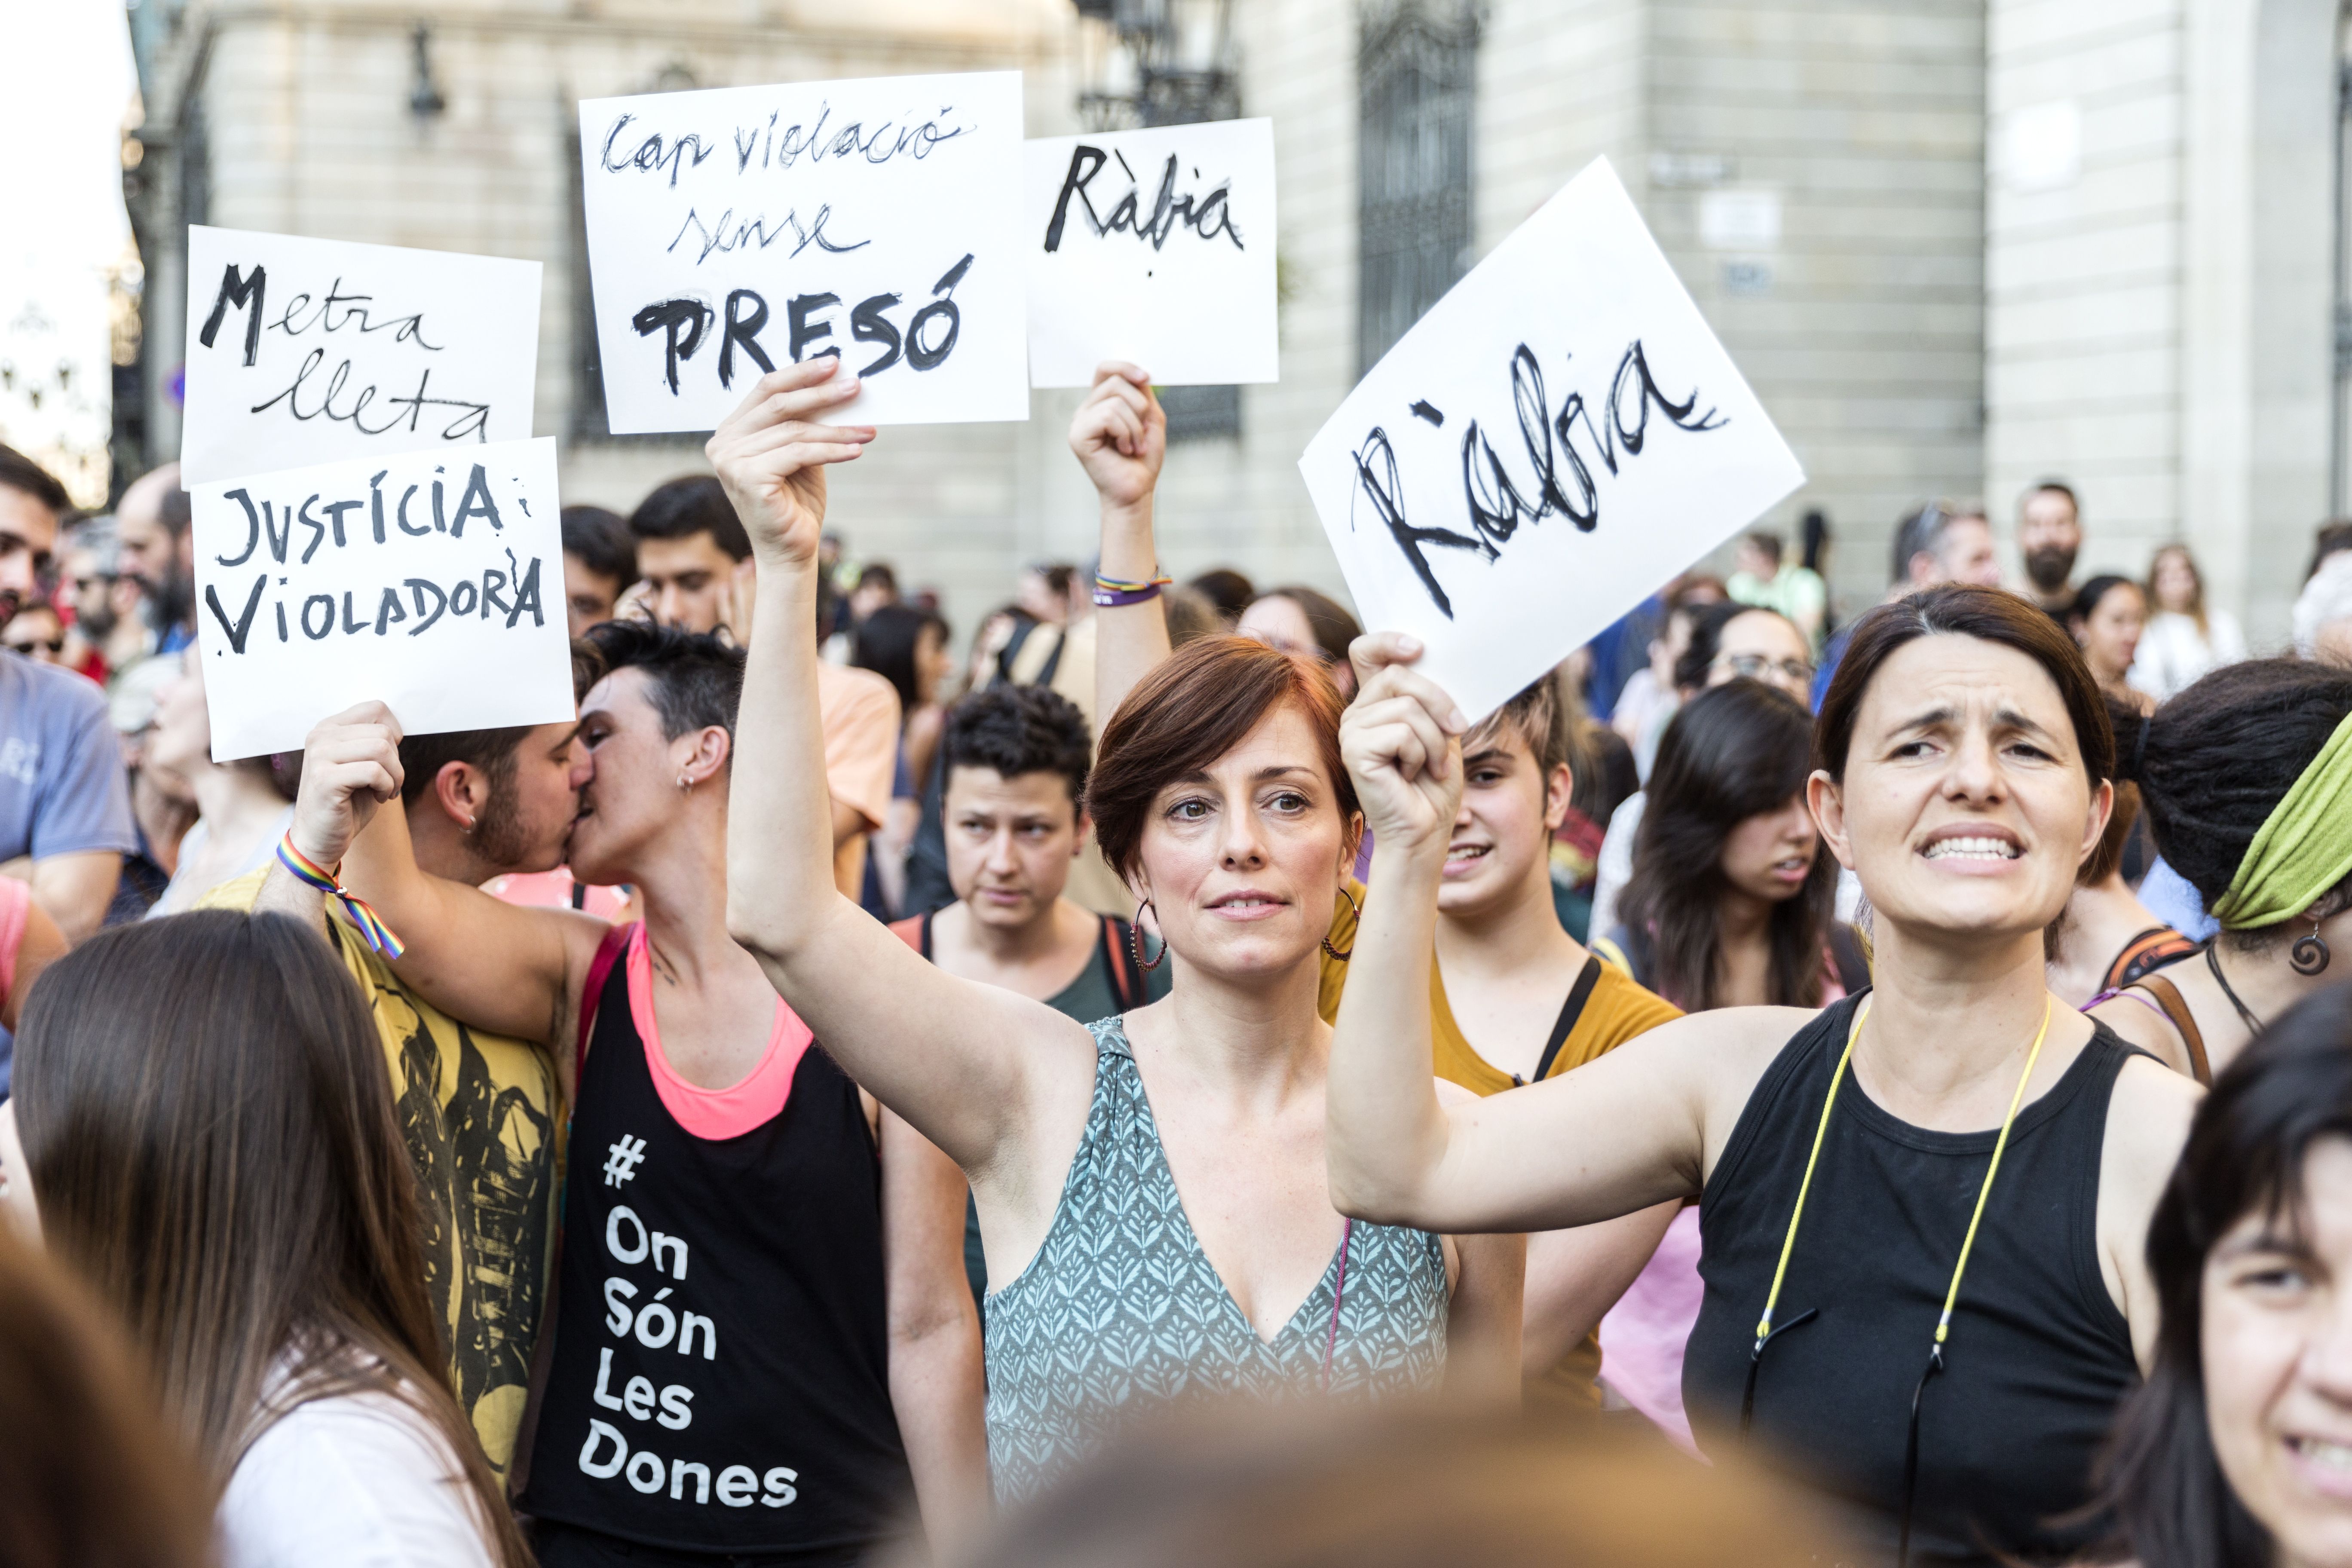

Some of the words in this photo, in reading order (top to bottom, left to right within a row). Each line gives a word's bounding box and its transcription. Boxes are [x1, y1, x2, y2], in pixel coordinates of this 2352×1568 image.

[601, 113, 714, 190] Cap
[667, 203, 871, 266] sense
[1044, 145, 1244, 253] Ràbia
[199, 263, 445, 367] Metra
[632, 253, 975, 396] PRESÓ
[251, 347, 491, 444] lleta
[603, 1134, 647, 1189] #
[606, 1205, 688, 1280] On
[604, 1277, 717, 1360] Són
[593, 1347, 694, 1430] Les
[578, 1418, 799, 1508] Dones
